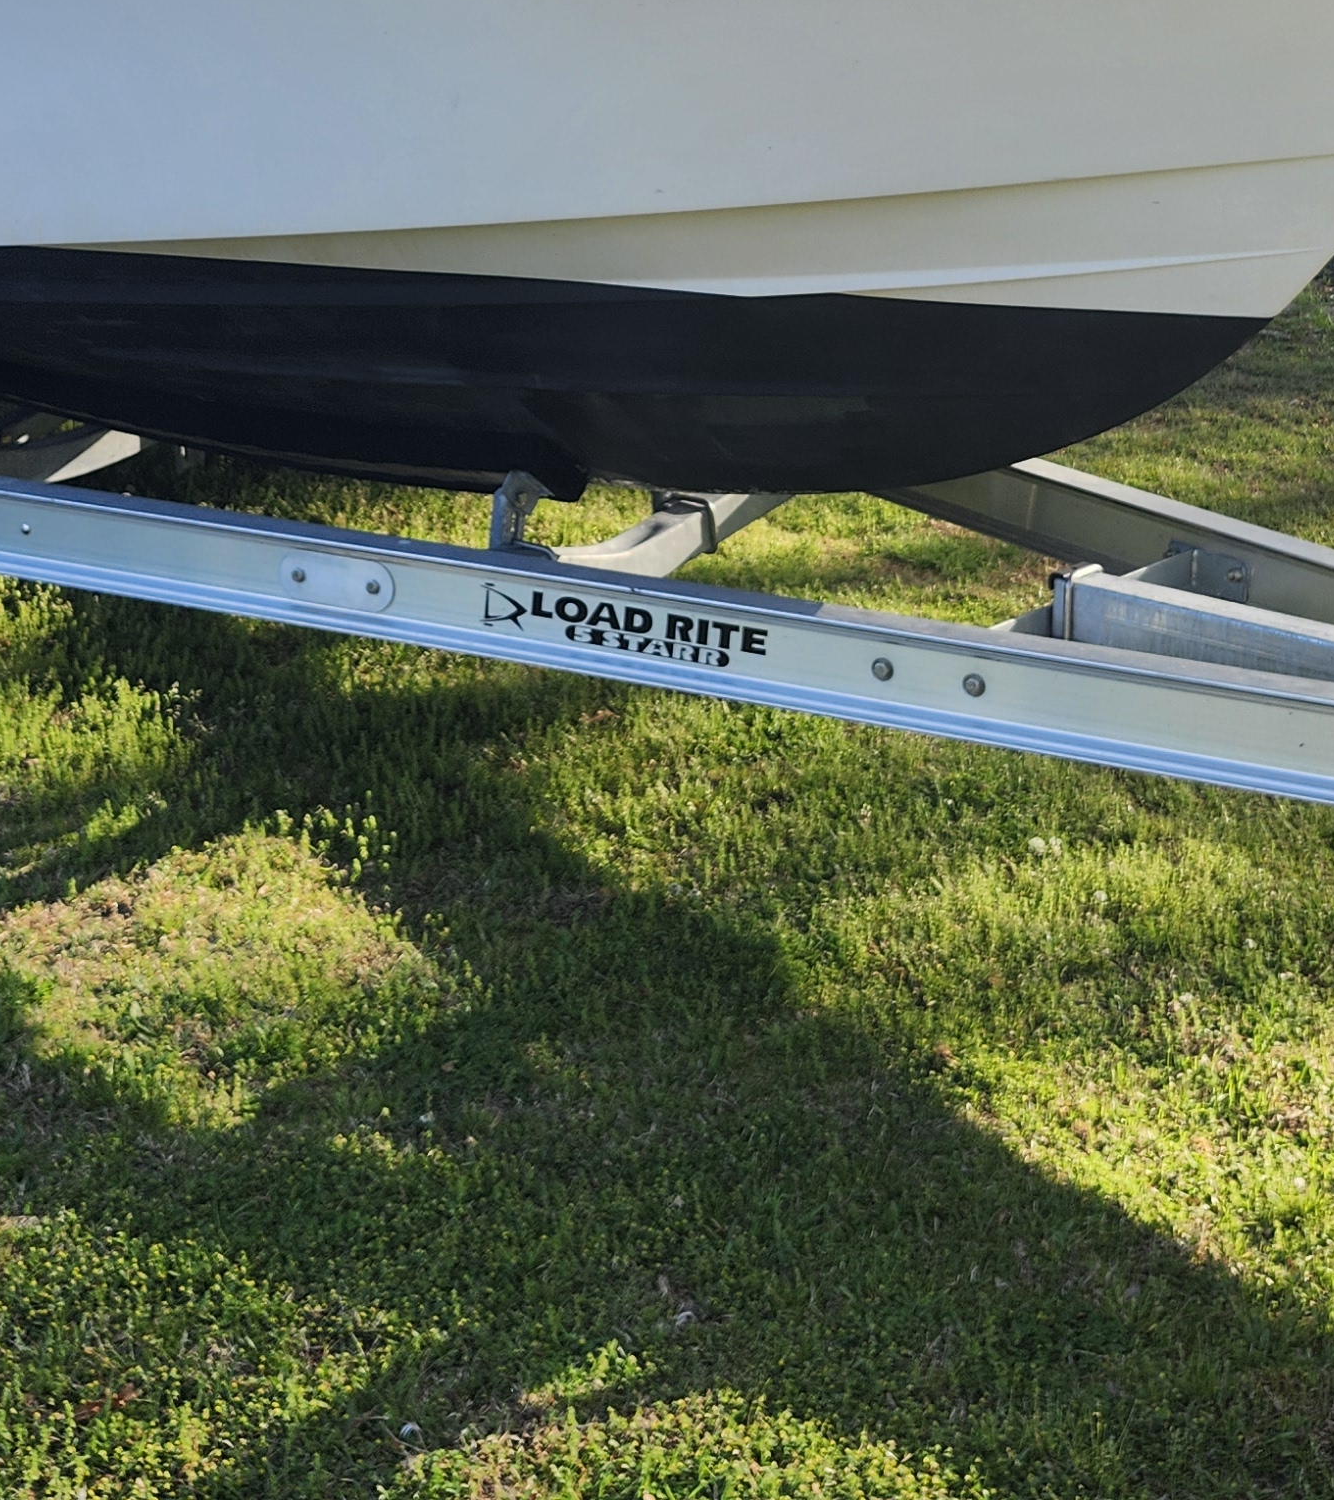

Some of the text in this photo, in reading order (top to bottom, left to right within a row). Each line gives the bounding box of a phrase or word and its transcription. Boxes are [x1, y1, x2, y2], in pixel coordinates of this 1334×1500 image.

[530, 590, 768, 656] LOAD RITE
[573, 624, 723, 666] 5 STARR
